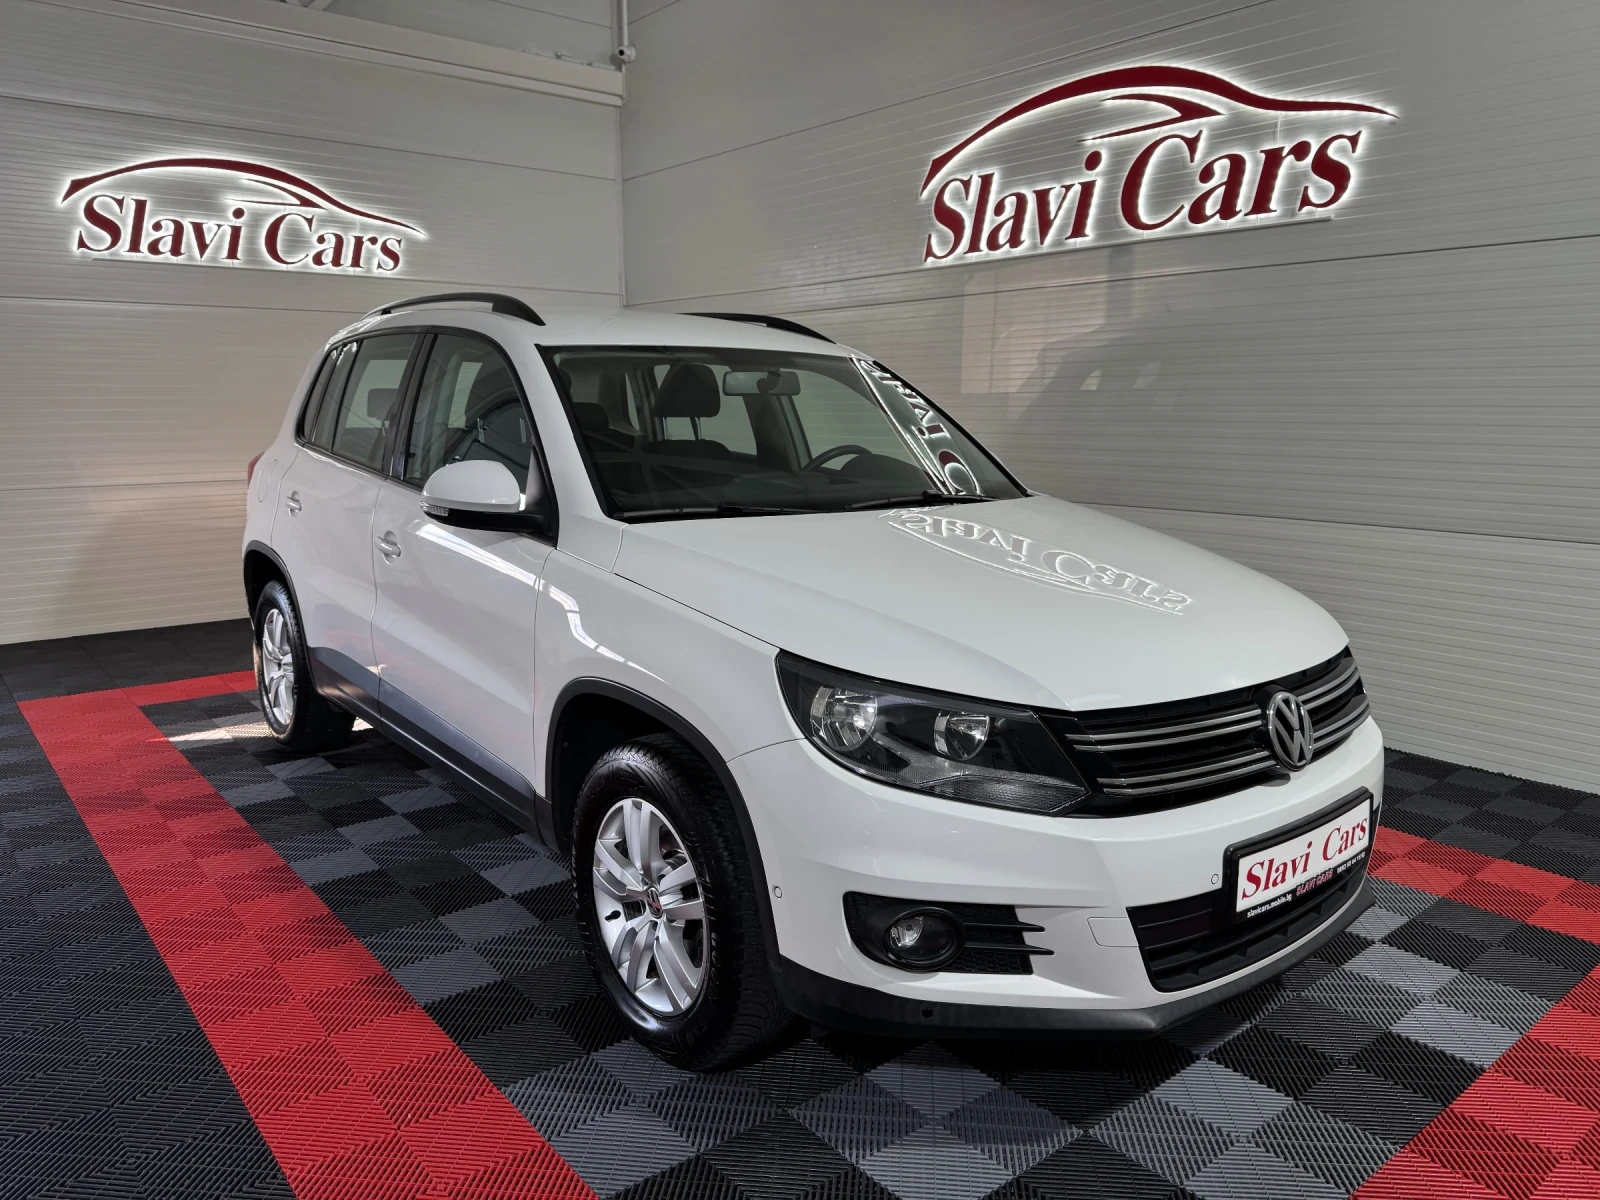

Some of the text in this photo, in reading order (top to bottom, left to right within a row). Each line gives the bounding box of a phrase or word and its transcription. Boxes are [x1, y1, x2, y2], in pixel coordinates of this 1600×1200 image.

[77, 194, 403, 272] Slavi Cars
[924, 130, 1363, 262] Slavi Cars
[1241, 817, 1368, 900] Slavi Cars
